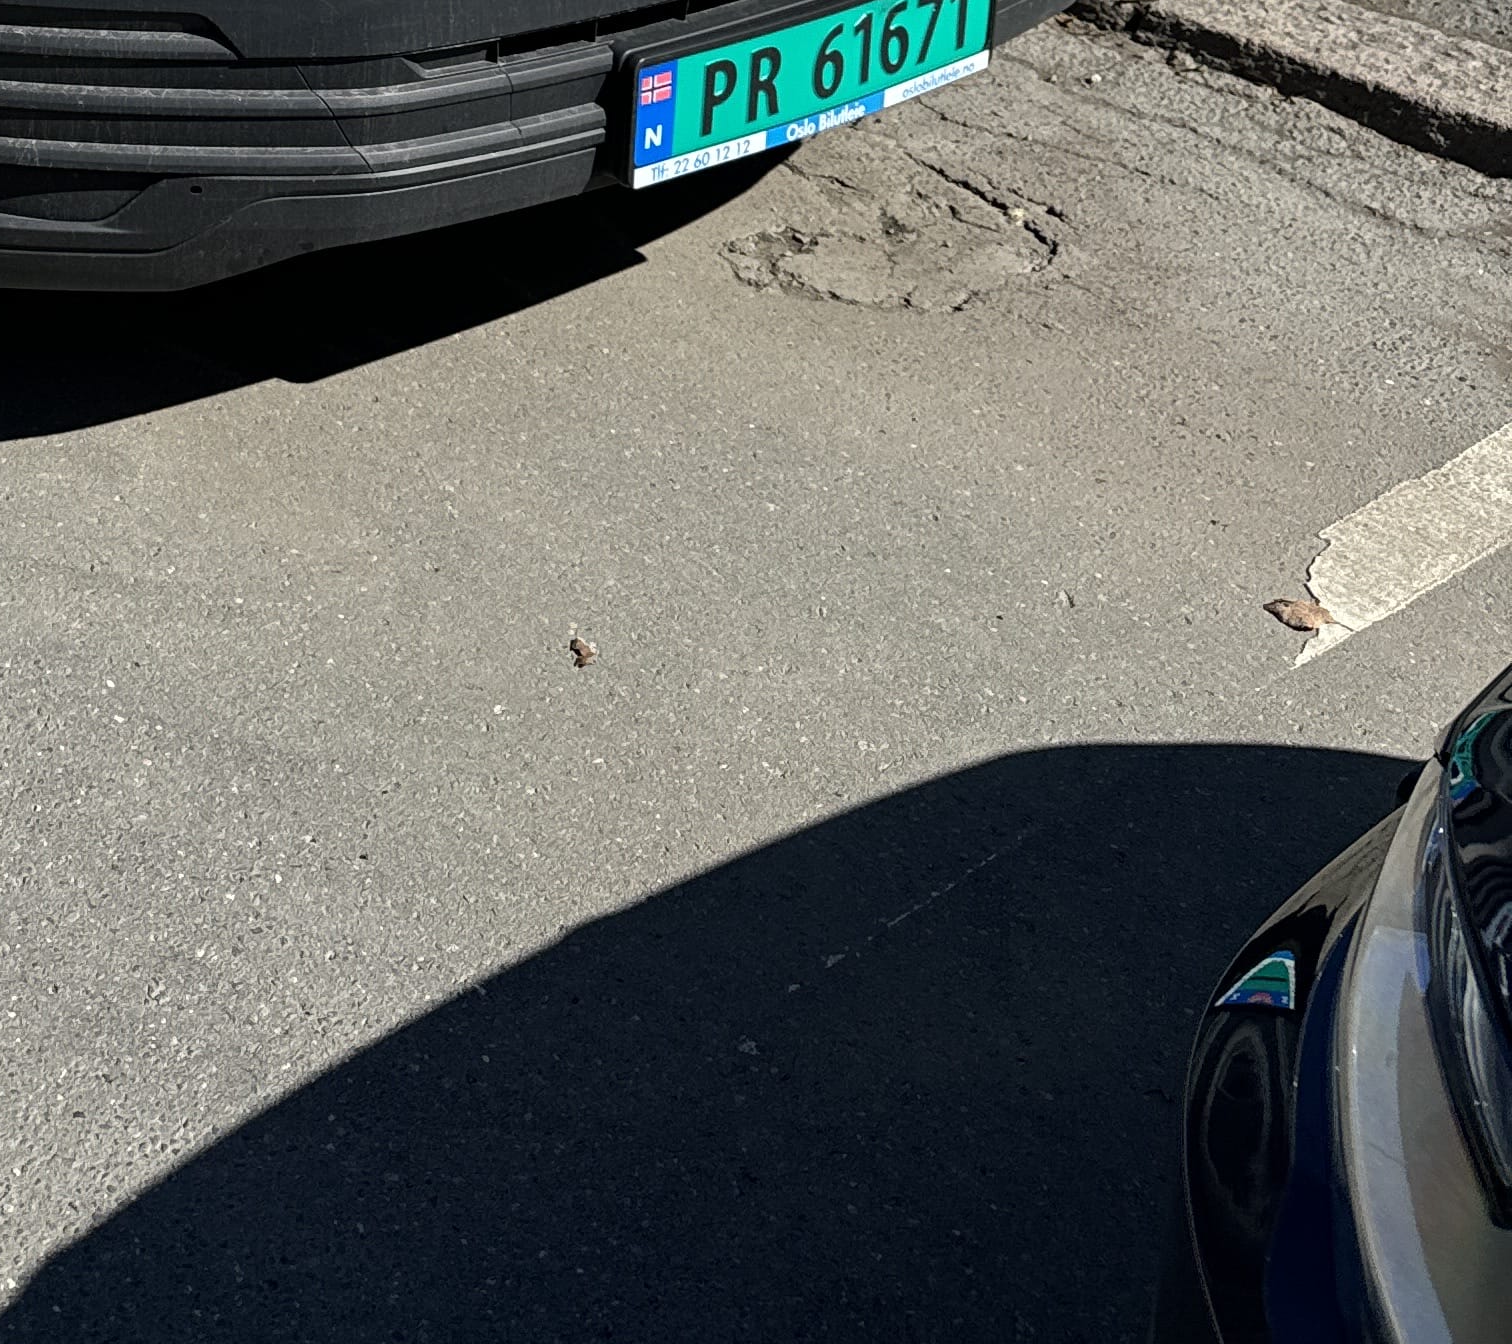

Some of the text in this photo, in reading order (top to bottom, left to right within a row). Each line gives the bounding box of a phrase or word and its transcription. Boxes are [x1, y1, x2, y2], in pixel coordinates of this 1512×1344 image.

[699, 45, 782, 138] PR
[643, 123, 663, 150] N
[786, 102, 866, 142] Oslo Bilutleie
[673, 158, 689, 175] 22
[693, 151, 710, 169] 60
[716, 145, 731, 162] 12
[737, 139, 751, 156] 12
